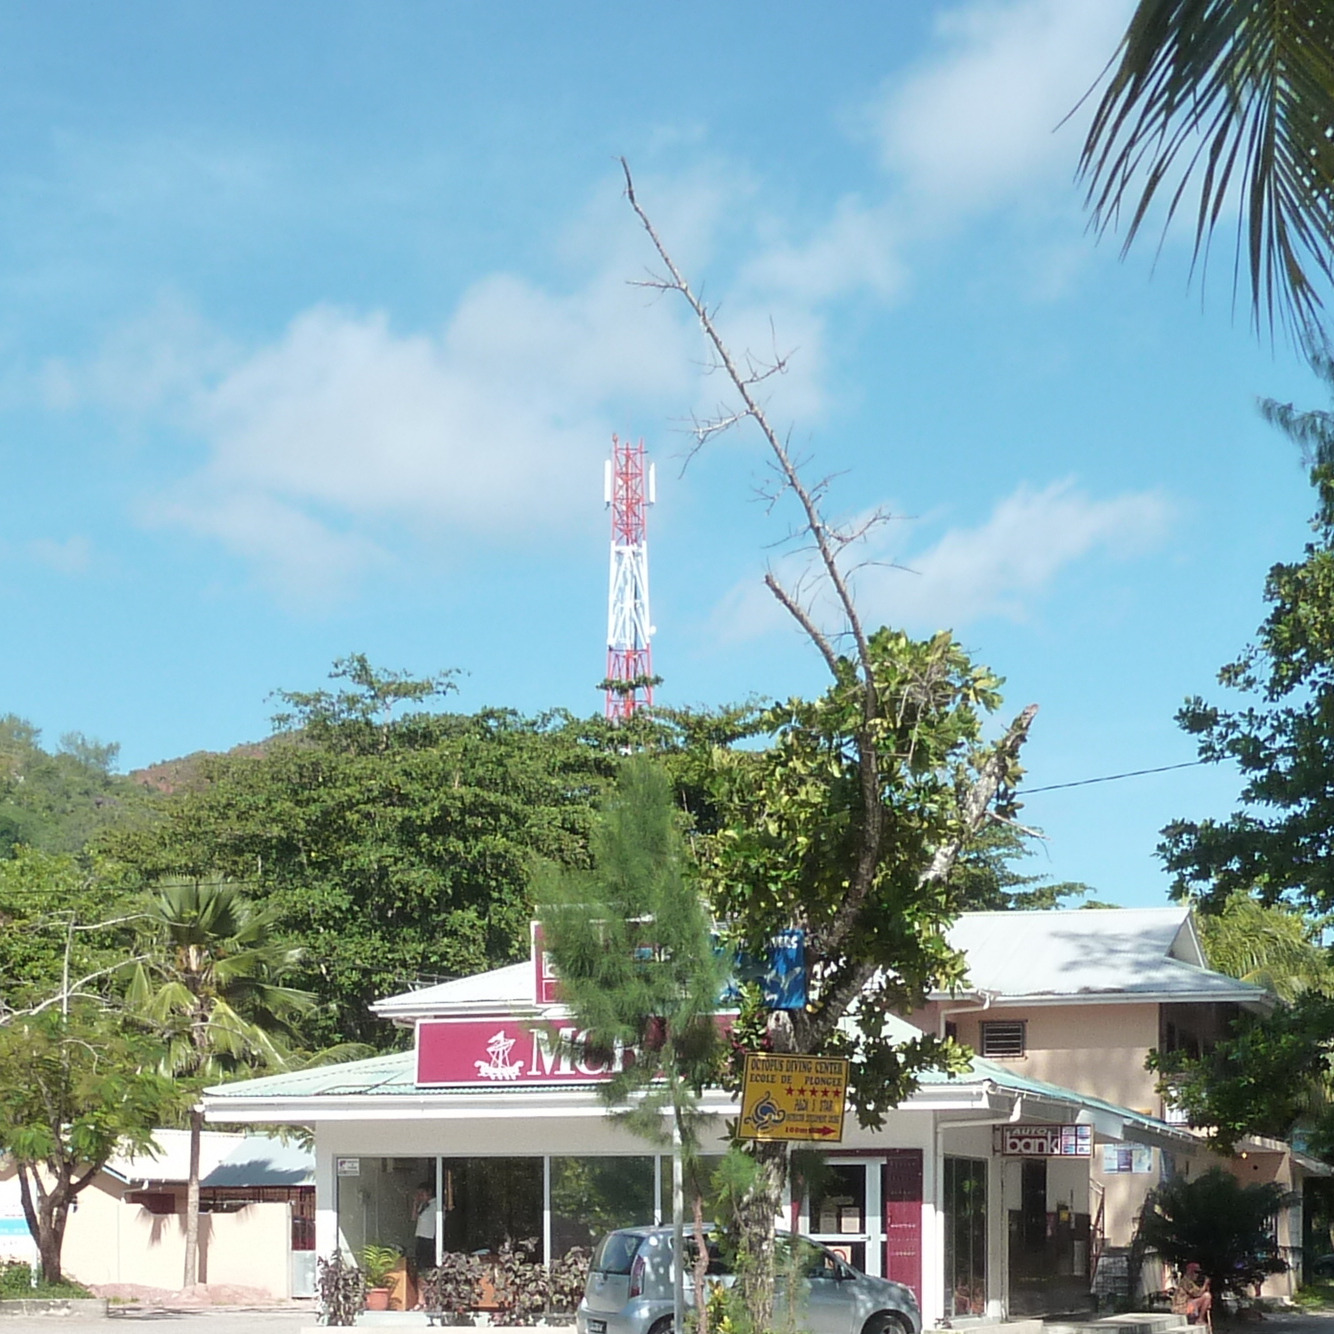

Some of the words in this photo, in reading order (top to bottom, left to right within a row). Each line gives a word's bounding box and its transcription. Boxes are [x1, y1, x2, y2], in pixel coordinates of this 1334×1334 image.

[751, 1059, 784, 1071] OCTOPUS
[785, 1060, 812, 1073] DIVING
[815, 1062, 842, 1074] CENTER
[750, 1073, 776, 1083] ECOLE
[781, 1075, 792, 1084] DE
[805, 1077, 842, 1087] PLONGEE
[1012, 1127, 1048, 1136] AUTO
[1006, 1130, 1060, 1154] bank
